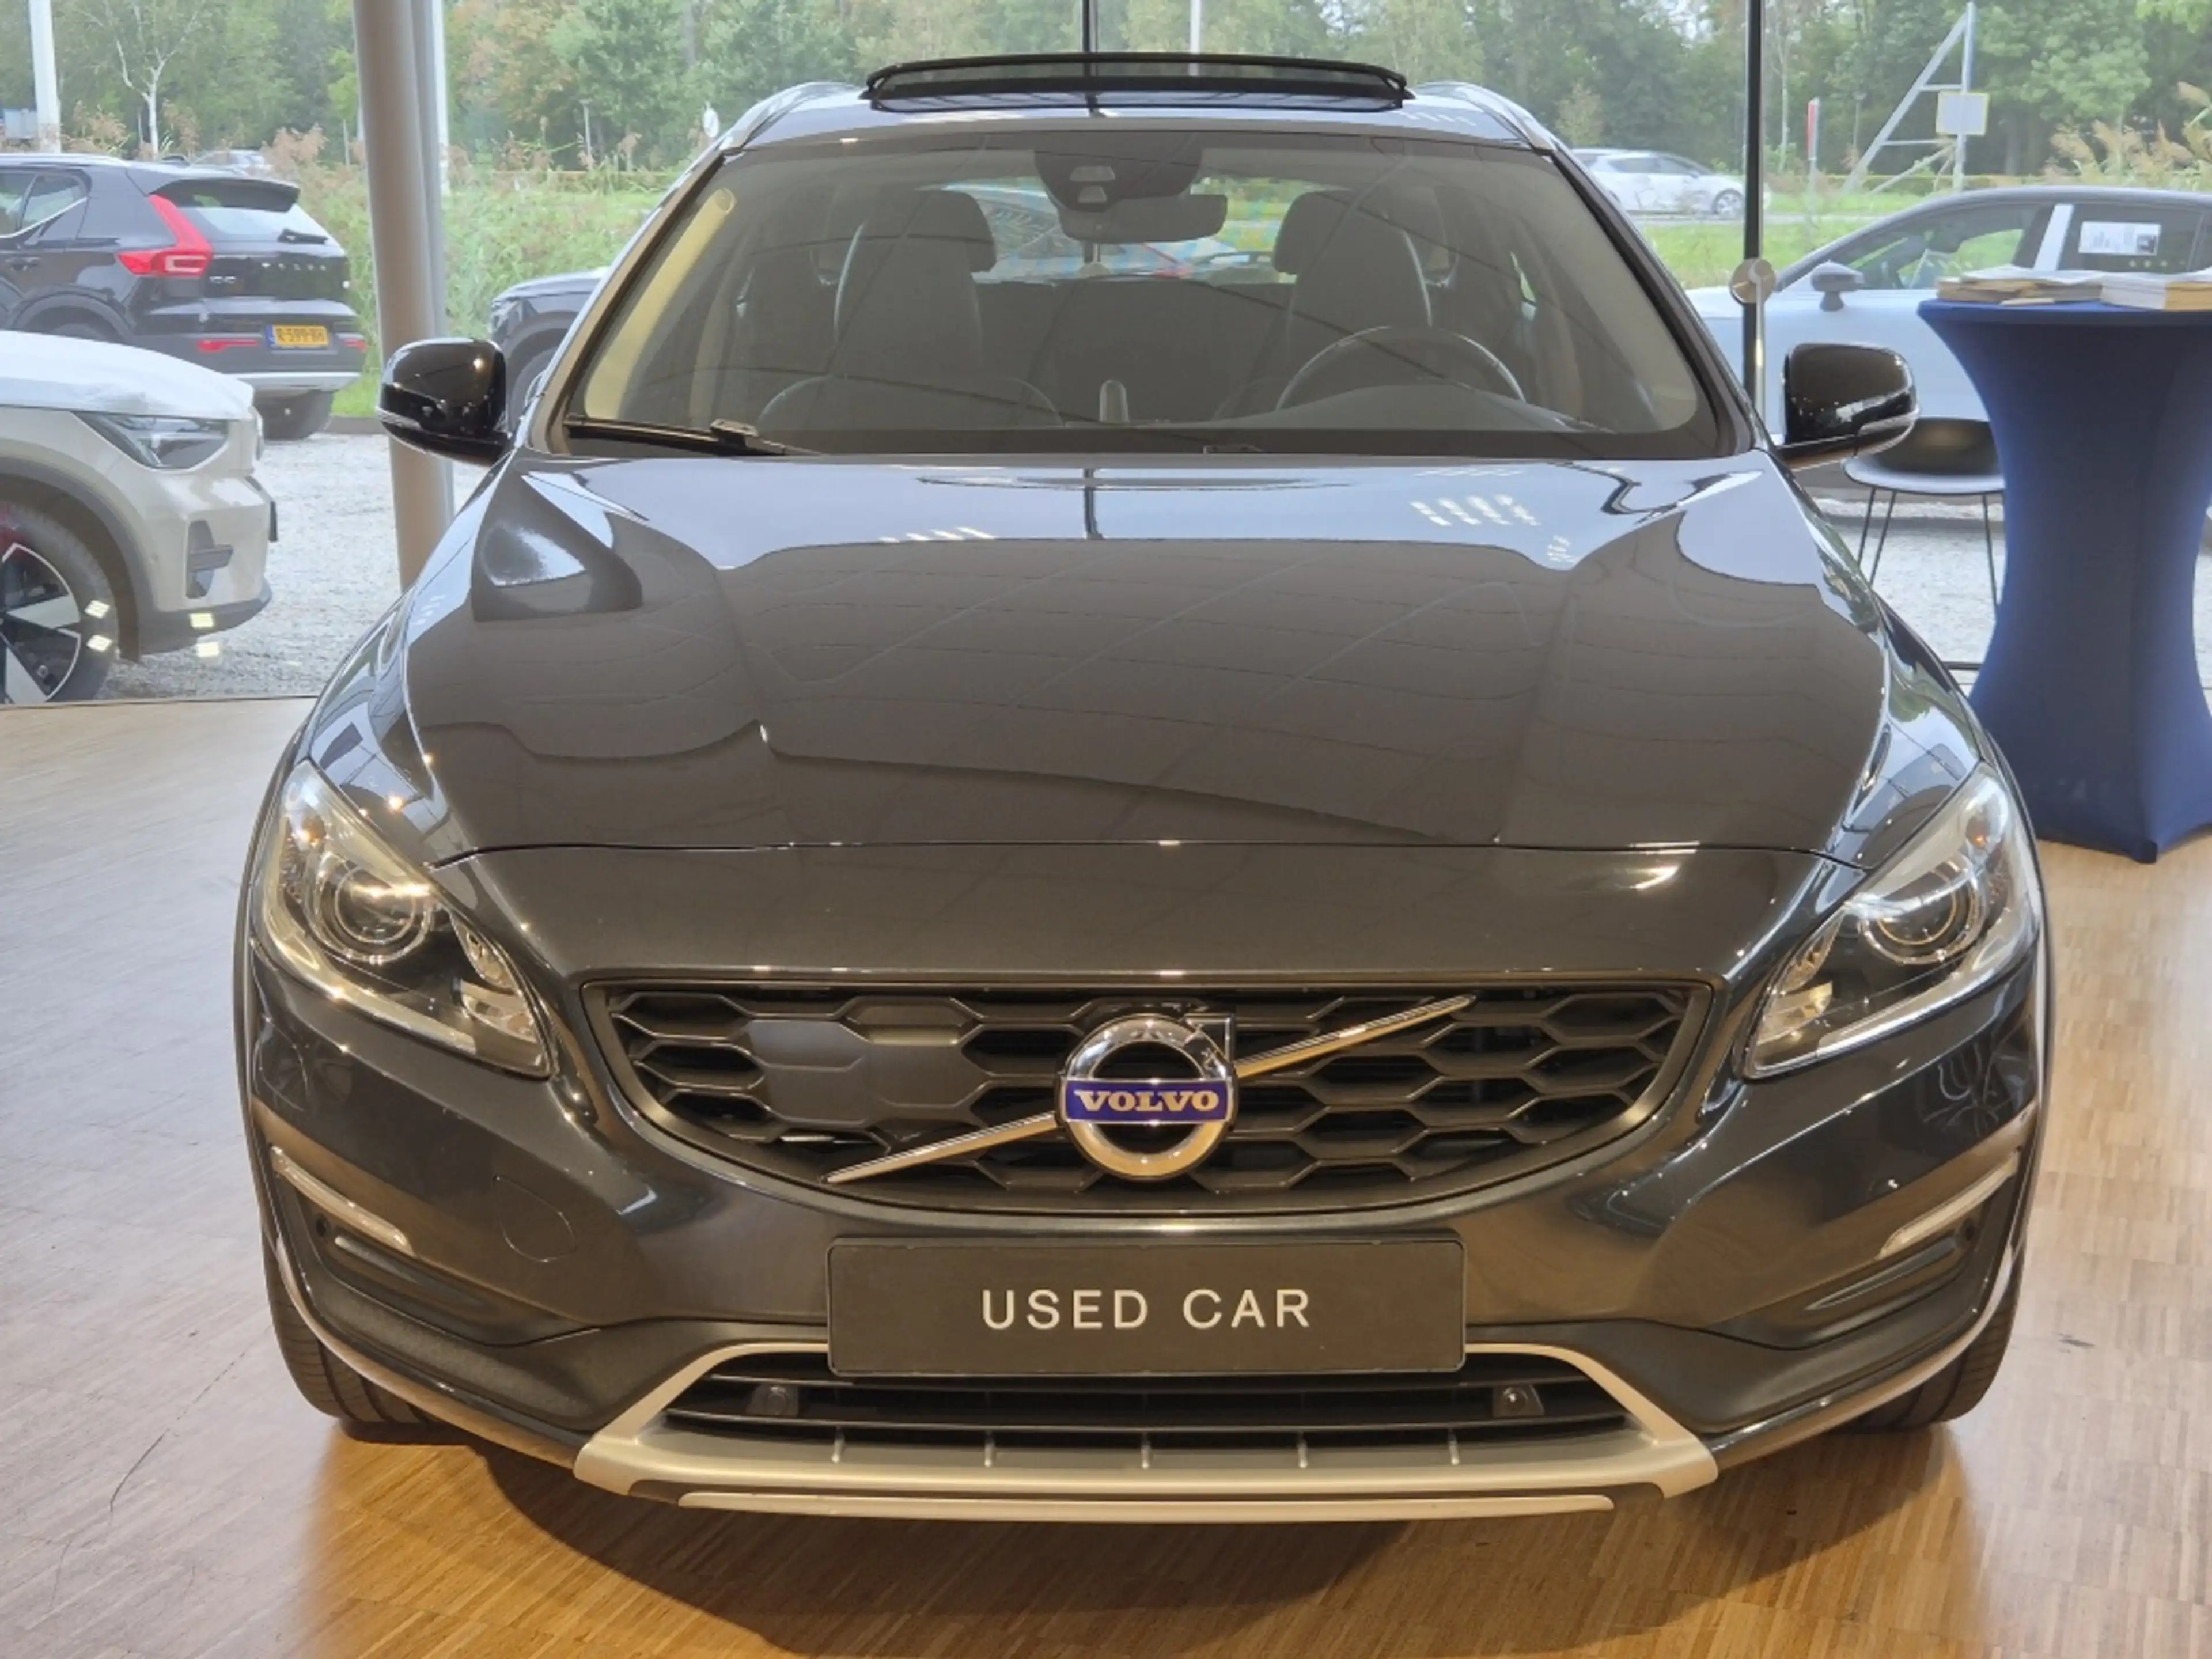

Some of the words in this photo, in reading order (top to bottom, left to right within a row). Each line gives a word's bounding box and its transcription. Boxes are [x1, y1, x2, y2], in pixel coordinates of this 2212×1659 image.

[1073, 1090, 1219, 1112] VOLVO
[982, 1289, 1149, 1330] USED
[1183, 1288, 1310, 1330] CAR
